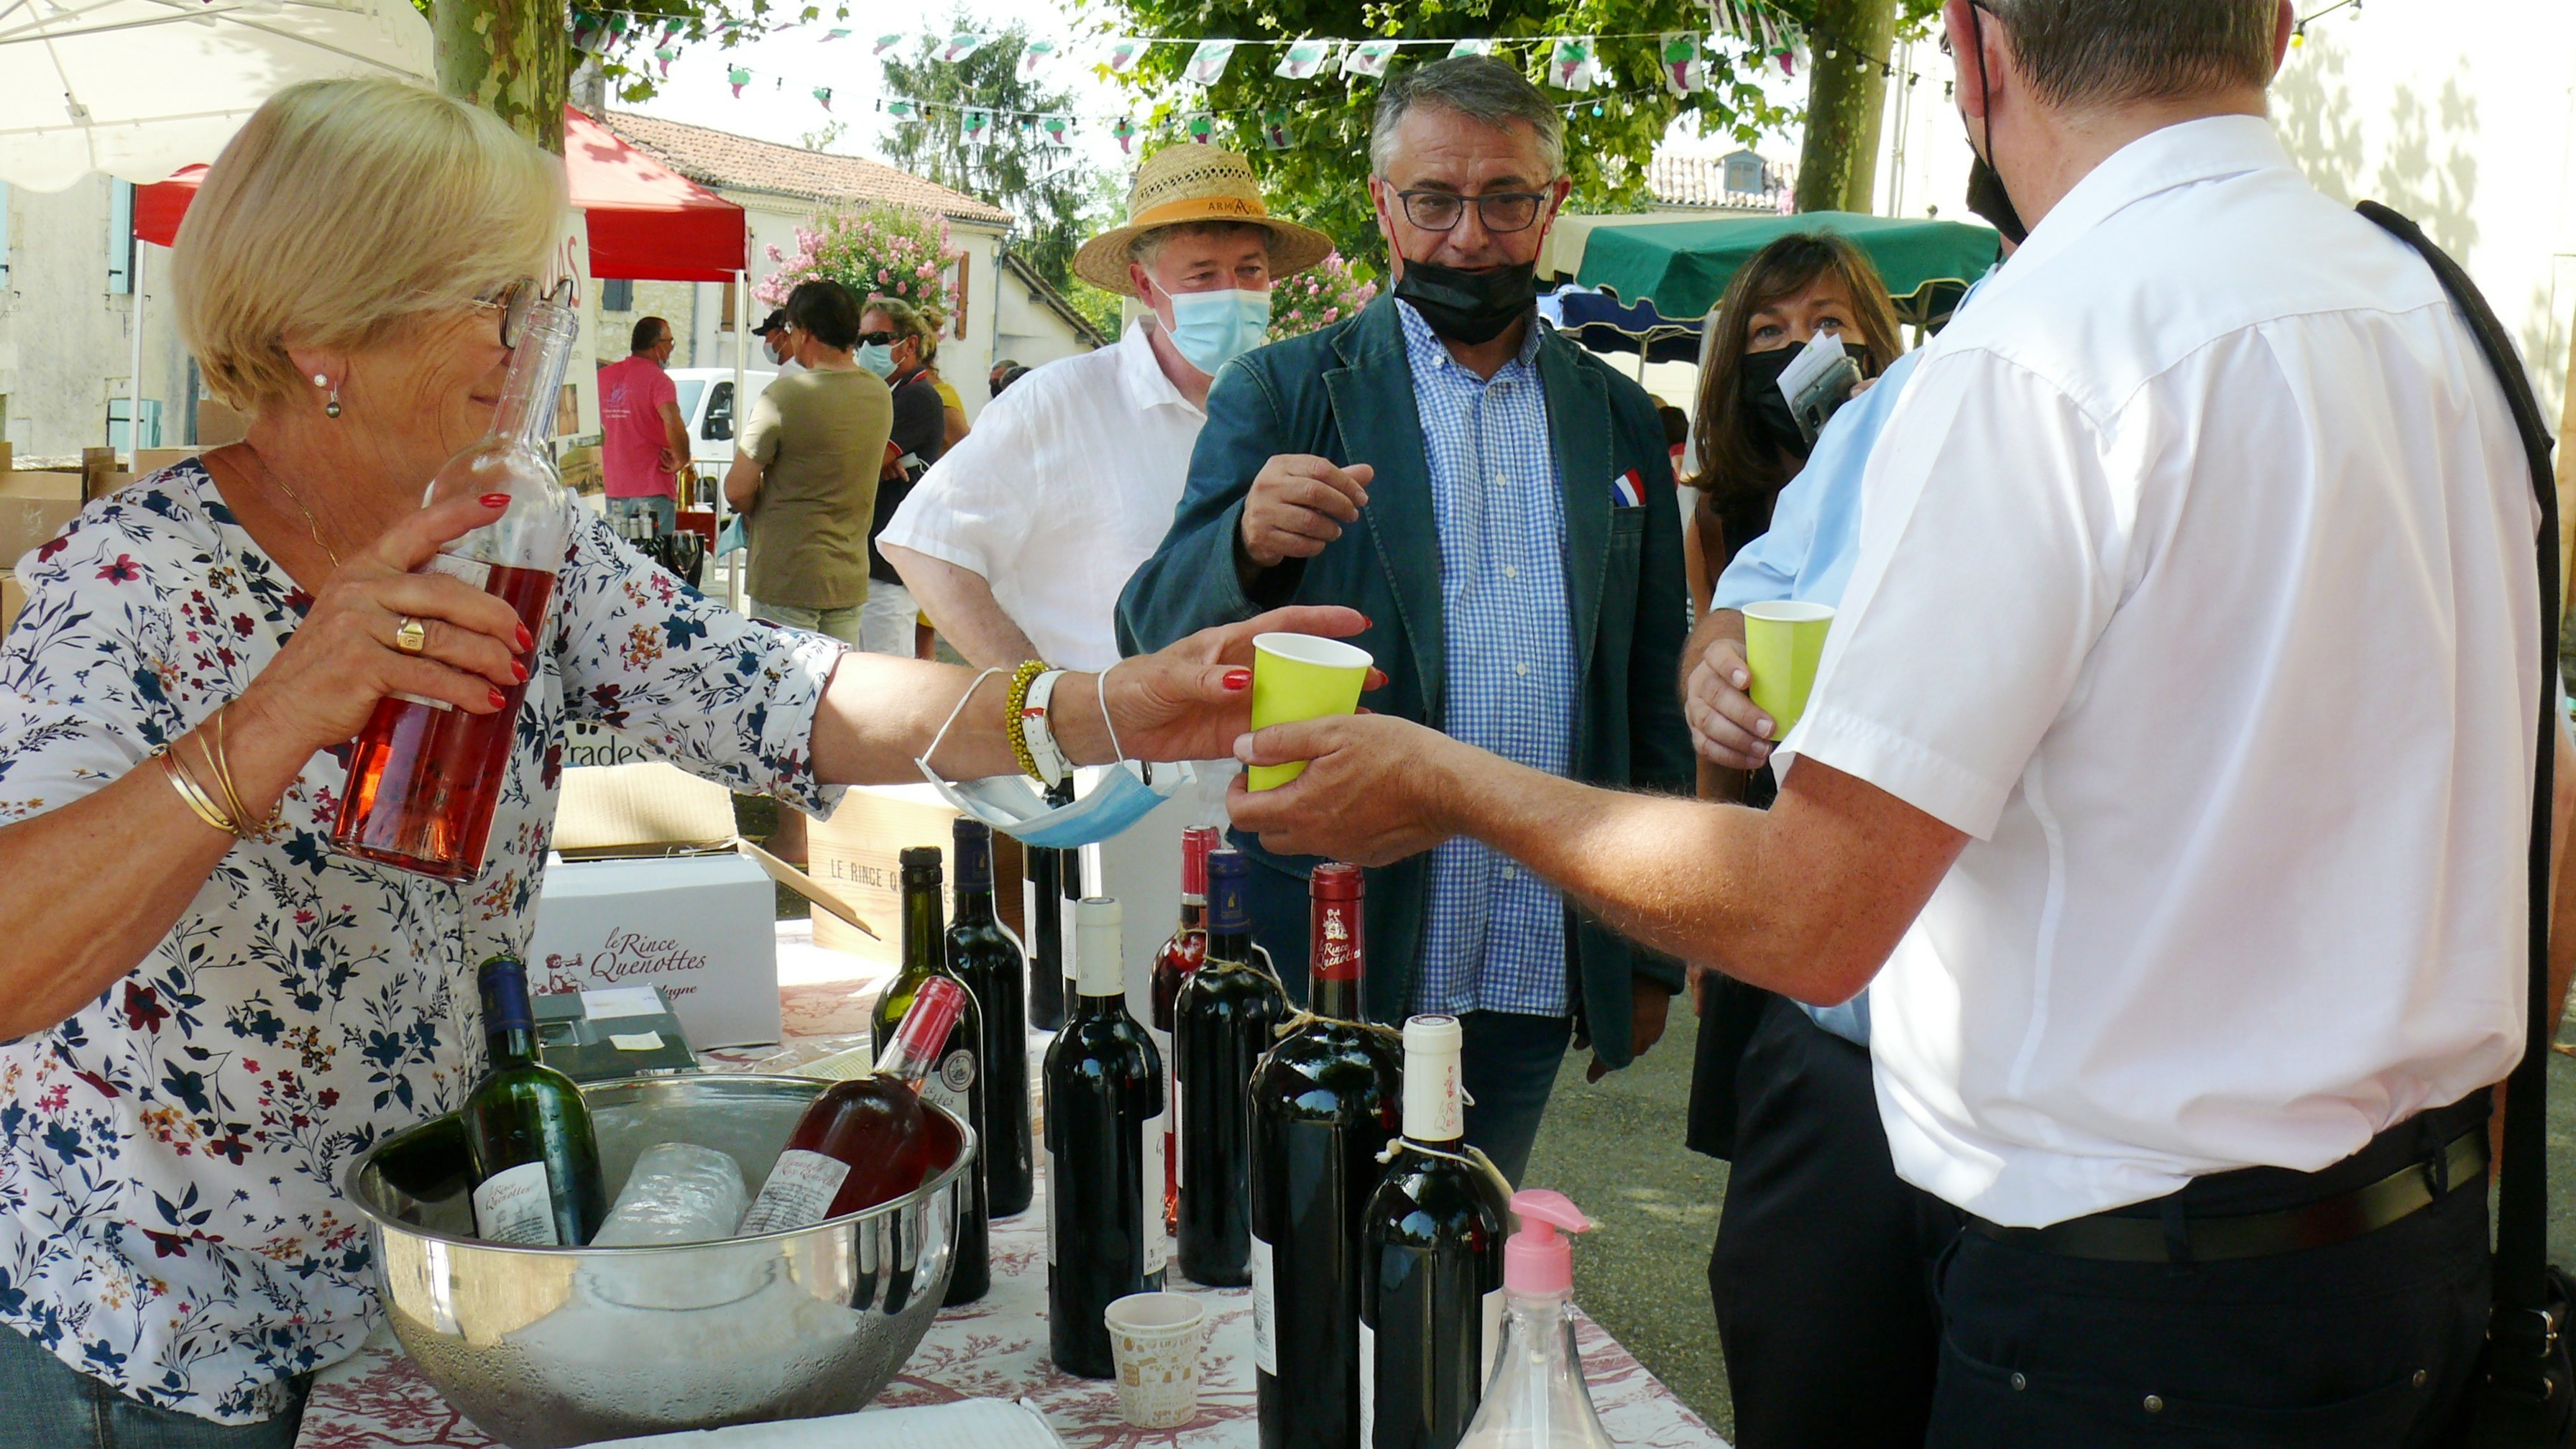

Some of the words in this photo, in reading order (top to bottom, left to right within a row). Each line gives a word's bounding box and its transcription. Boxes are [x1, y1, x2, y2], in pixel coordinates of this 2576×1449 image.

[831, 859, 843, 880] LE
[851, 862, 883, 888] RINCE
[605, 926, 620, 949] le
[618, 933, 679, 959] Rince
[589, 949, 707, 983] Quenottes
